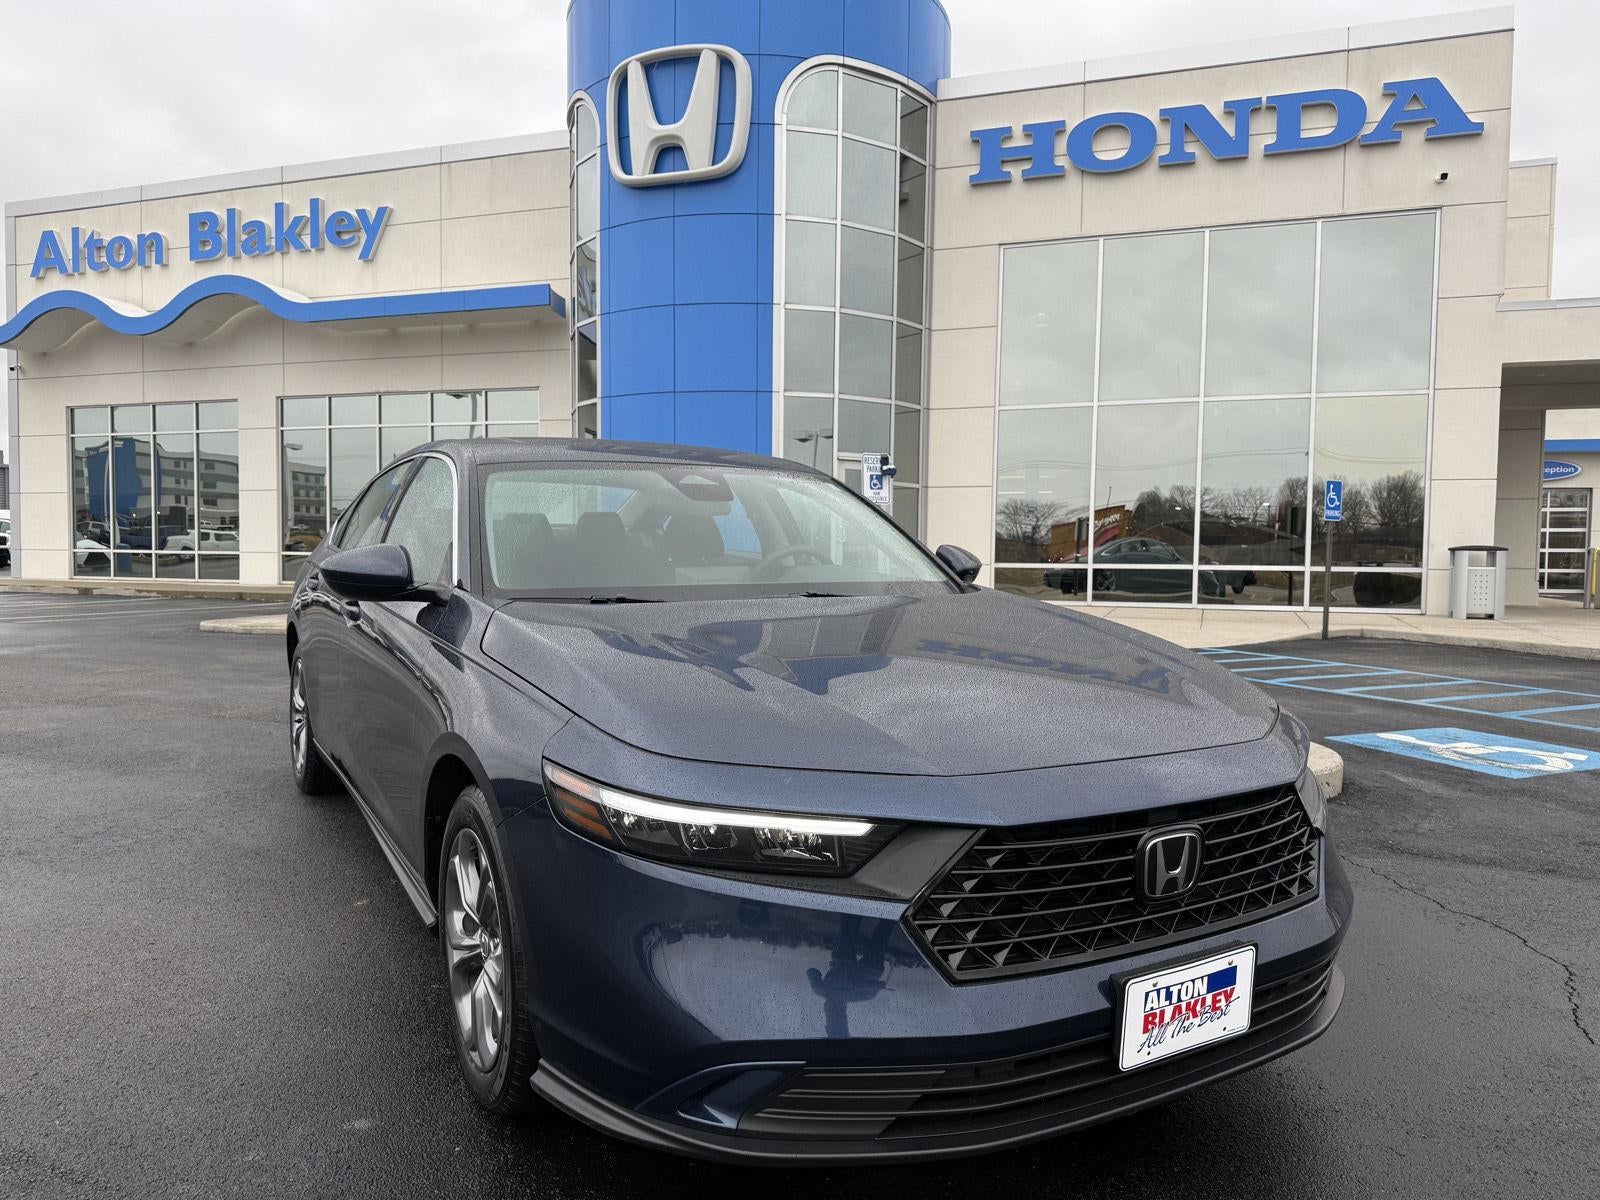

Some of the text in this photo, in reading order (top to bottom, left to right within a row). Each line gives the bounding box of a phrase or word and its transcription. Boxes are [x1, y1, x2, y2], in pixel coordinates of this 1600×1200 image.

[969, 77, 1484, 186] HONDA
[30, 197, 393, 279] Alton Blakley
[1142, 987, 1236, 1034] BLAKLEY
[1144, 976, 1208, 1012] ALTON
[1137, 996, 1240, 1053] All The Best
